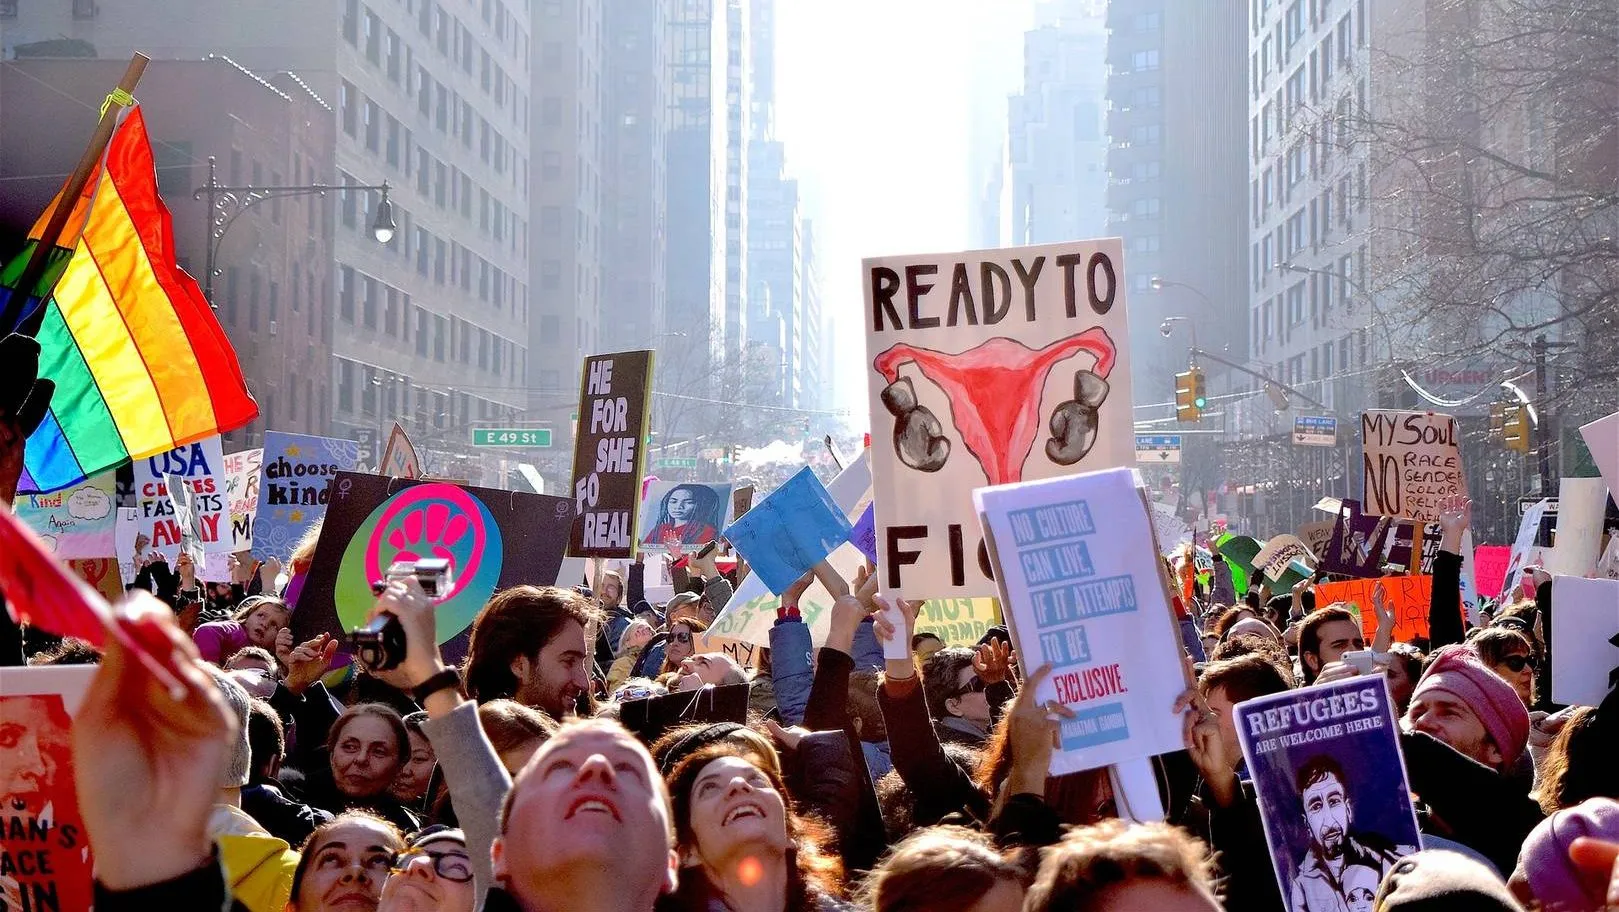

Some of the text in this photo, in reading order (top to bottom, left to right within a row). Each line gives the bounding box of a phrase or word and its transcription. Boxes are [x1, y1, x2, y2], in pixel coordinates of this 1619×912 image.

[871, 252, 1116, 332] READY TO
[588, 360, 613, 395] HE
[590, 397, 628, 434] FOR
[1362, 413, 1457, 447] MY SOUL
[487, 432, 537, 444] E 49 St
[596, 437, 635, 473] SHE
[149, 442, 212, 478] USA
[265, 456, 338, 479] choose
[1403, 451, 1456, 468] RACE
[30, 493, 63, 508] Kind
[267, 479, 334, 506] kind
[576, 472, 600, 515] FO
[1363, 452, 1400, 515] NO
[1406, 482, 1457, 495] COLOR
[48, 514, 75, 533] Again
[152, 513, 221, 548] AWY
[583, 512, 630, 549] REAL
[1011, 503, 1093, 542] NO CULTURE
[886, 523, 995, 589] FI
[1022, 549, 1055, 583] CAN
[1032, 578, 1135, 626] IF IT ATTEMPTS
[722, 641, 754, 665] MY
[1042, 629, 1088, 663] TO BE
[1053, 664, 1128, 705] EXCLUSIVE.
[1247, 688, 1380, 737] REFUGEES
[1255, 715, 1383, 755] ARE WELCOME HERE
